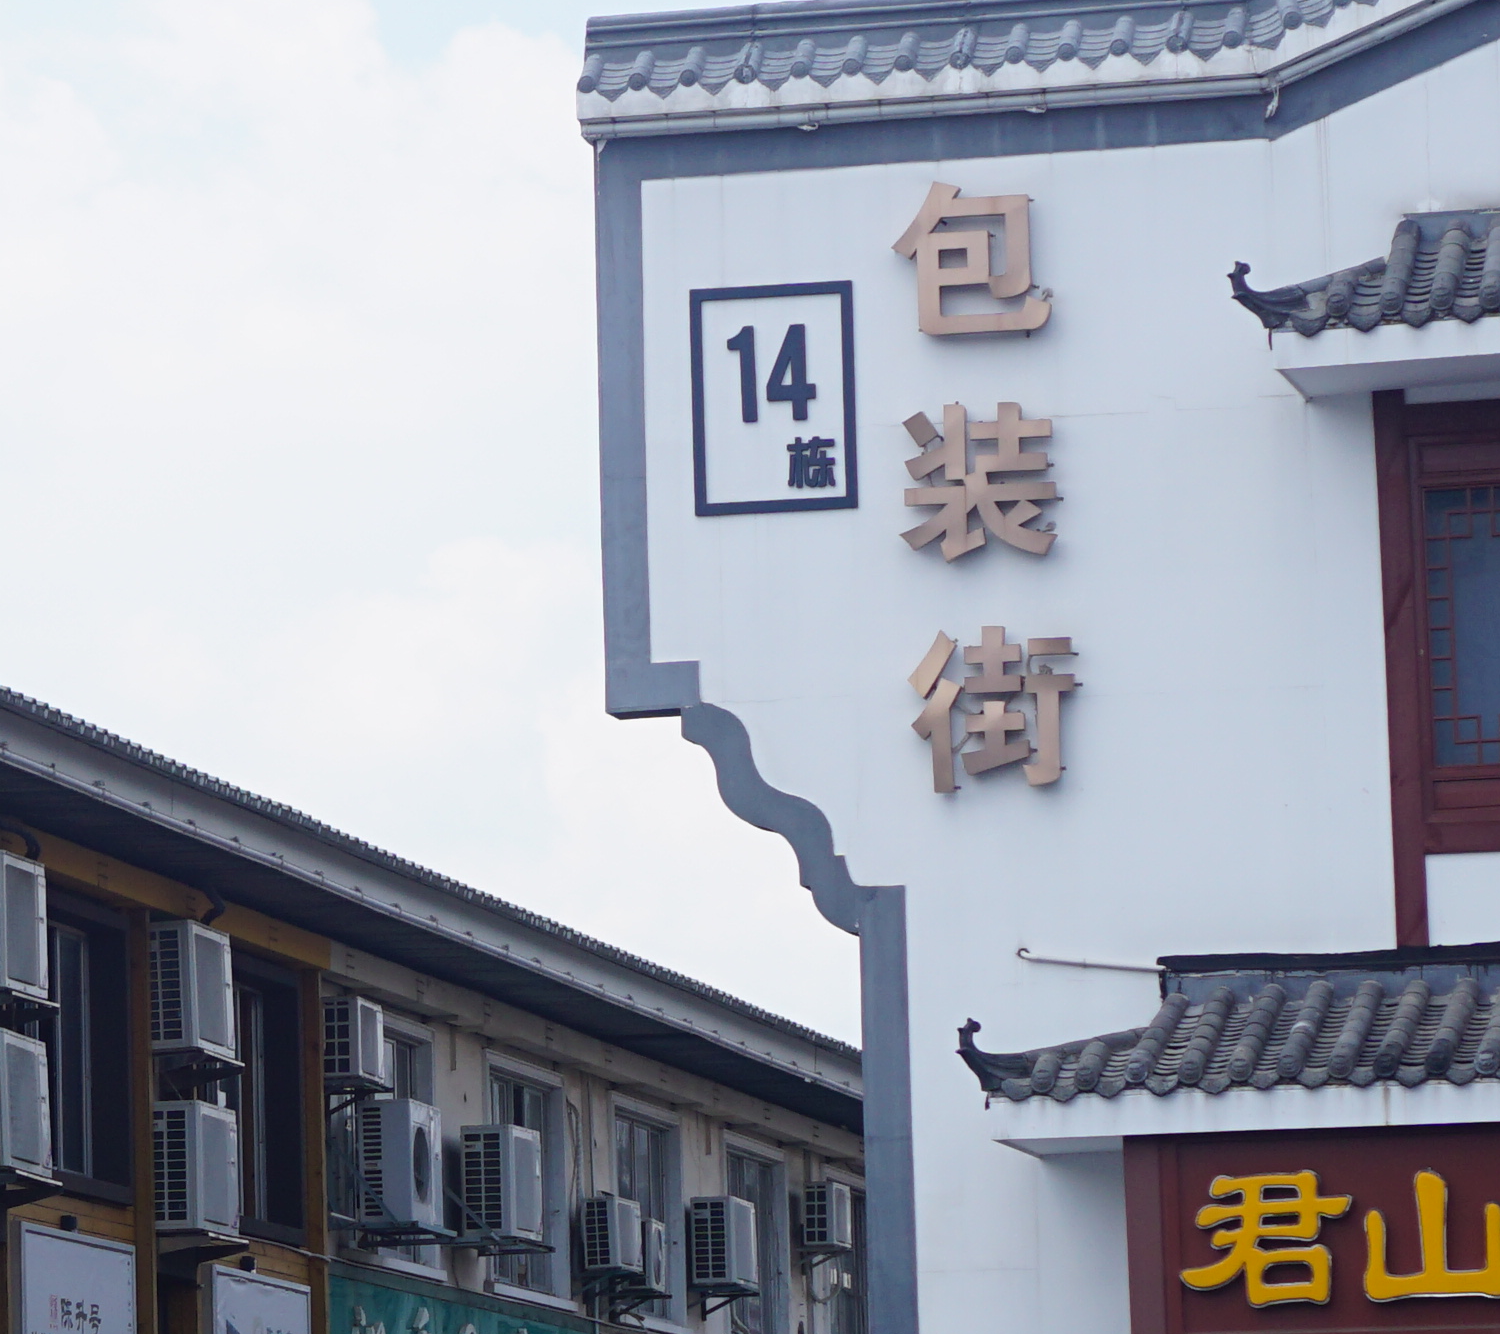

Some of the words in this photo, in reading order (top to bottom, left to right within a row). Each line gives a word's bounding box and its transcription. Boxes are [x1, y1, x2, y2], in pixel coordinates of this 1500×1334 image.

[727, 323, 817, 423] 14
[787, 436, 836, 489] 栋
[891, 181, 1078, 794] 包装街
